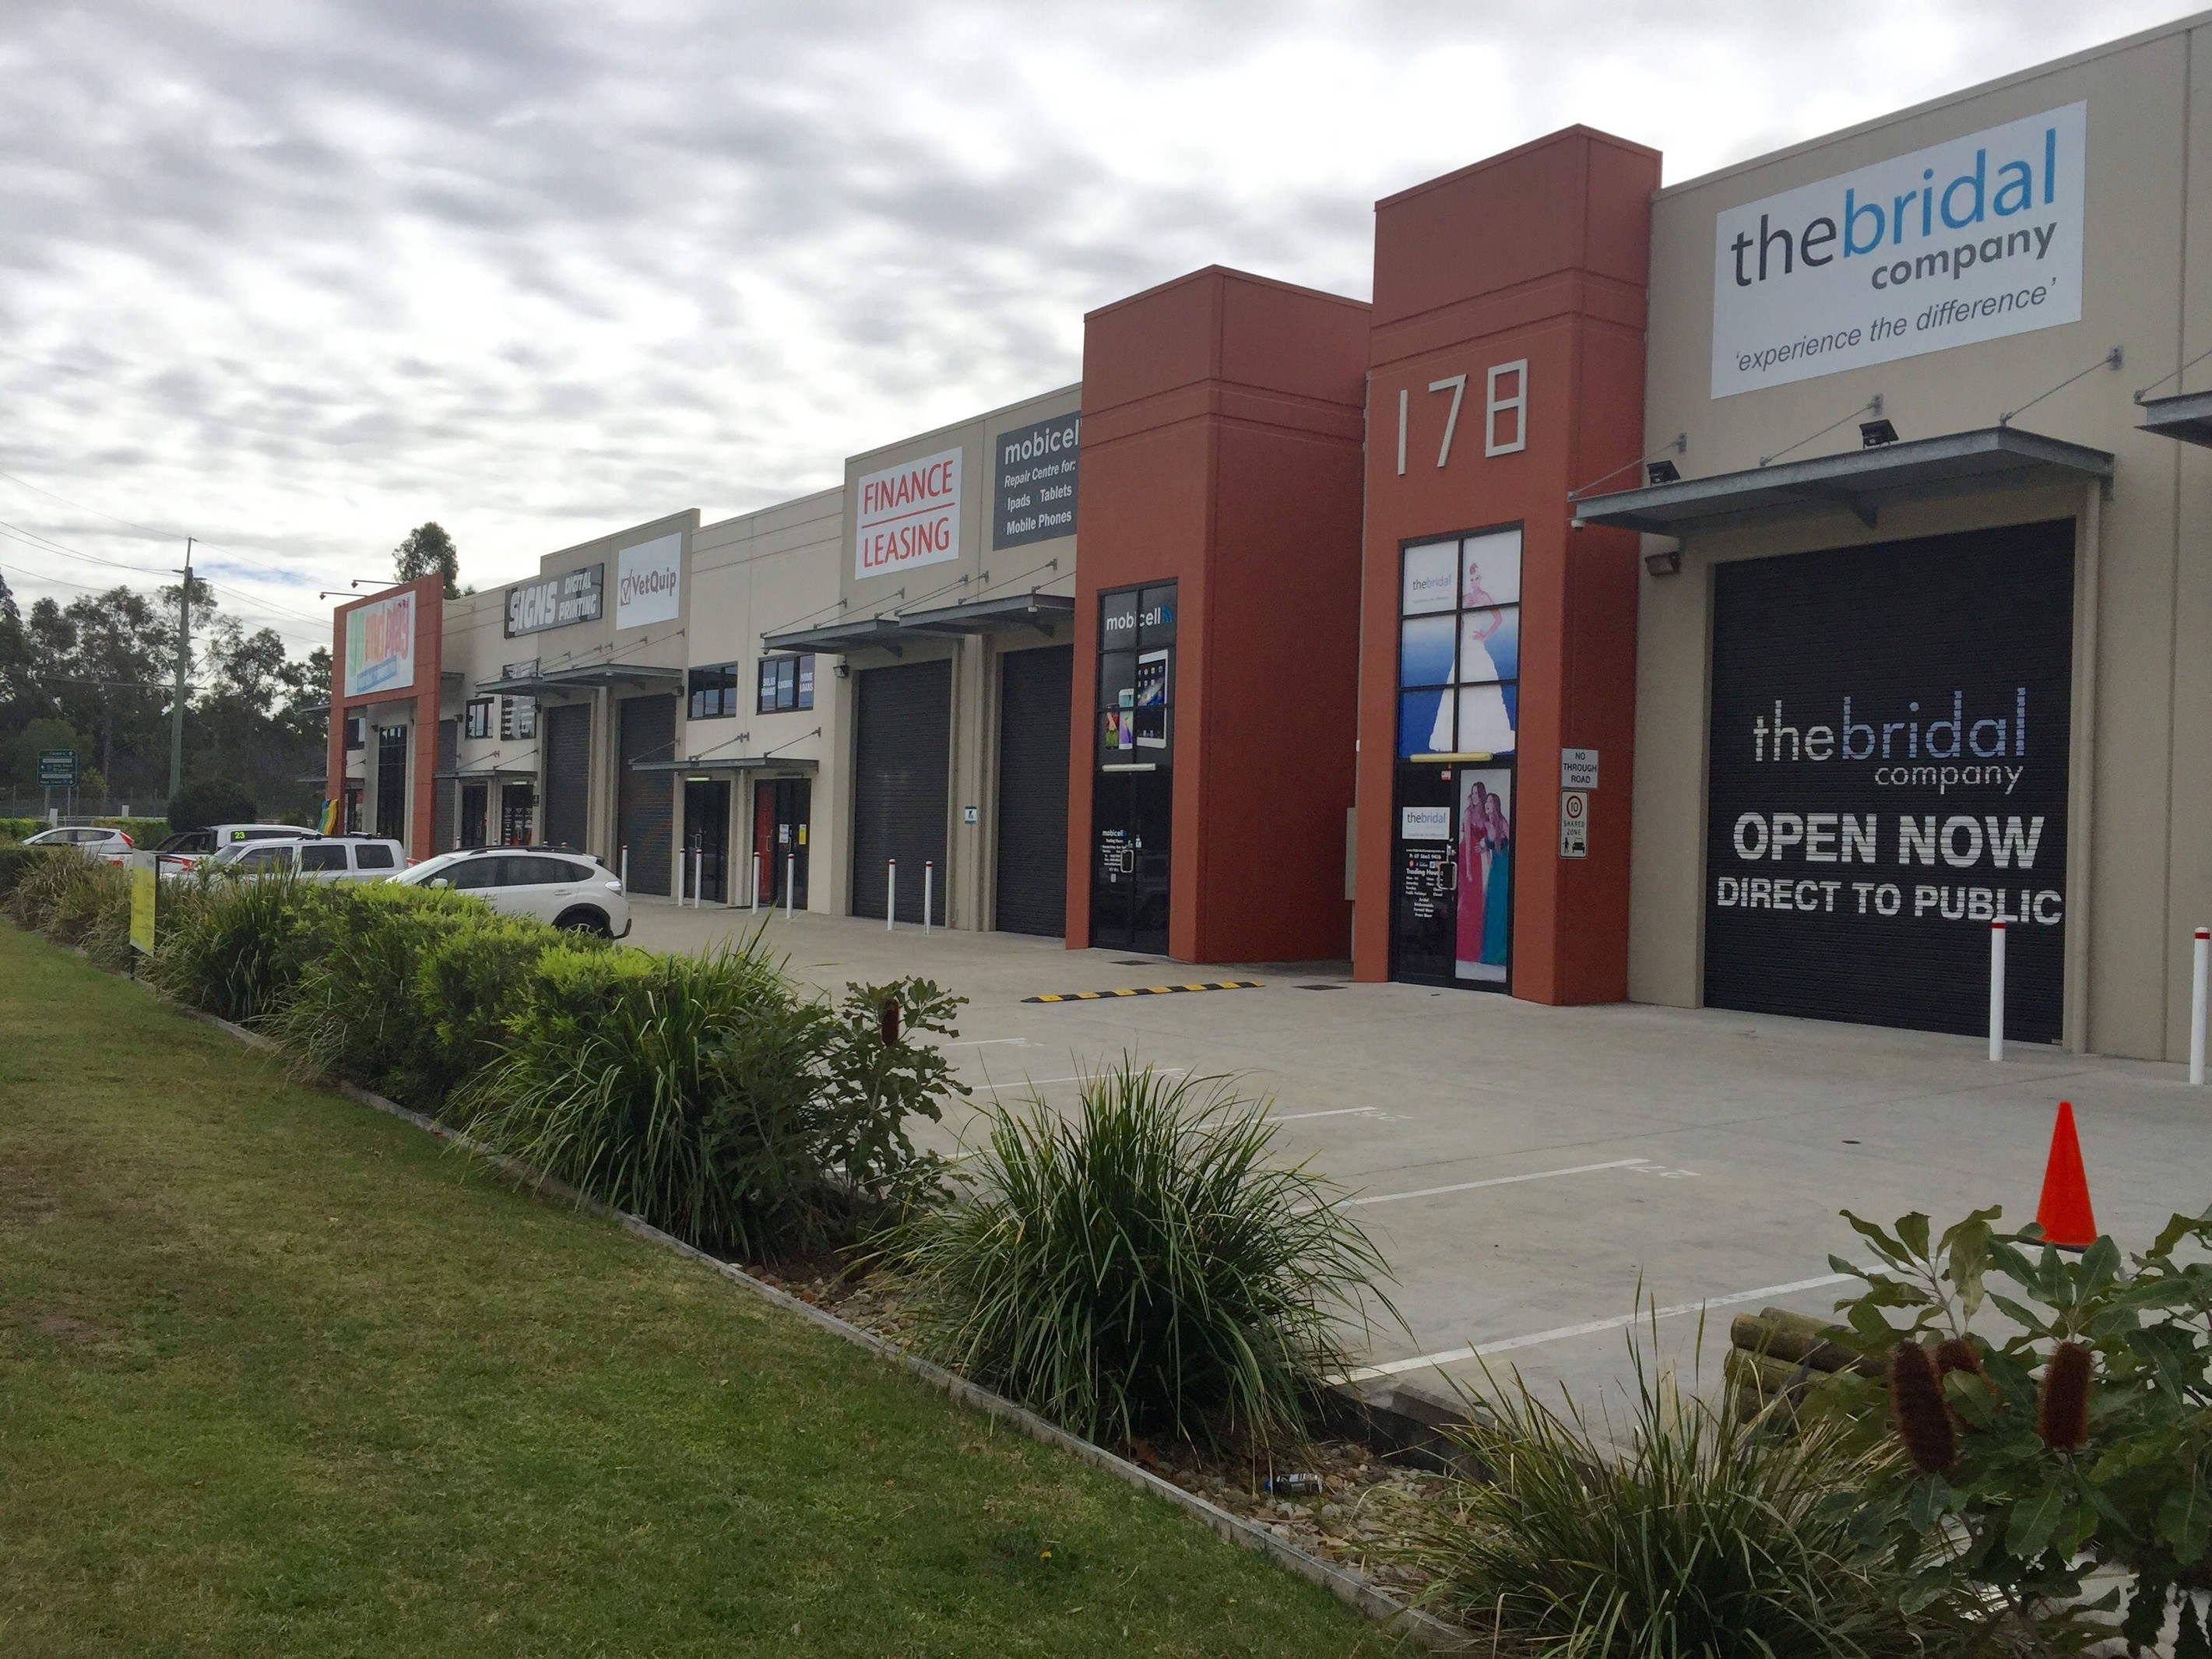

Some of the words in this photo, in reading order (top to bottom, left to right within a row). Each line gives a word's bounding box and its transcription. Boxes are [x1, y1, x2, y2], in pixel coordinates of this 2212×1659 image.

[1872, 222, 2057, 290] company
[1869, 315, 1908, 343] the
[1398, 358, 1528, 476] 178
[863, 459, 953, 515] FINANCE
[1004, 470, 1031, 489] Repair
[1032, 464, 1060, 481] Centre
[1061, 459, 1076, 474] for:
[1007, 493, 1031, 513] Ipads
[1039, 483, 1072, 503] Tablets
[1007, 517, 1036, 536] Mobile
[1039, 511, 1071, 529] Phones
[864, 516, 950, 568] LEASING
[564, 571, 592, 595] DIGITAL
[632, 567, 677, 598] VetQuip
[508, 581, 558, 633] SIGNS
[558, 593, 597, 621] PRINTING
[1106, 607, 1161, 631] mobicell
[1563, 763, 1597, 772] THROUGH
[1575, 752, 1586, 761] NO
[1571, 775, 1591, 784] ROAD
[1874, 765, 2024, 795] company
[1570, 802, 1578, 812] 10
[1733, 812, 1877, 864] OPEN
[1898, 815, 2045, 869] NOW
[1717, 877, 1842, 912] DIRECT
[1852, 883, 1902, 916] TO
[1913, 884, 2063, 926] PUBLIC
